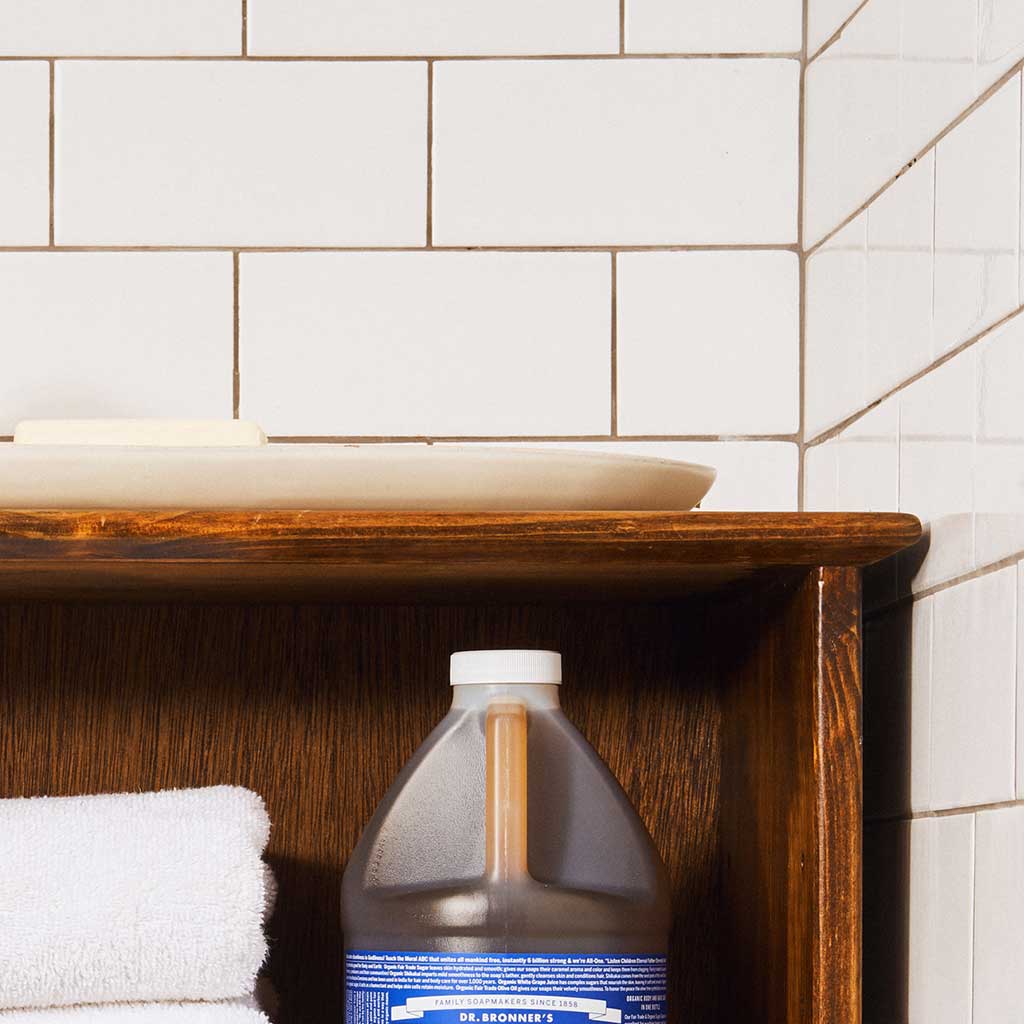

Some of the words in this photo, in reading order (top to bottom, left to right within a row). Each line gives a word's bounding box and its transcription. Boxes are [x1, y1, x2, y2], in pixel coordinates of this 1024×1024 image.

[559, 1000, 578, 1008] 1858
[459, 1013, 480, 1022] DR.
[482, 1013, 553, 1023] BRONNER'S
